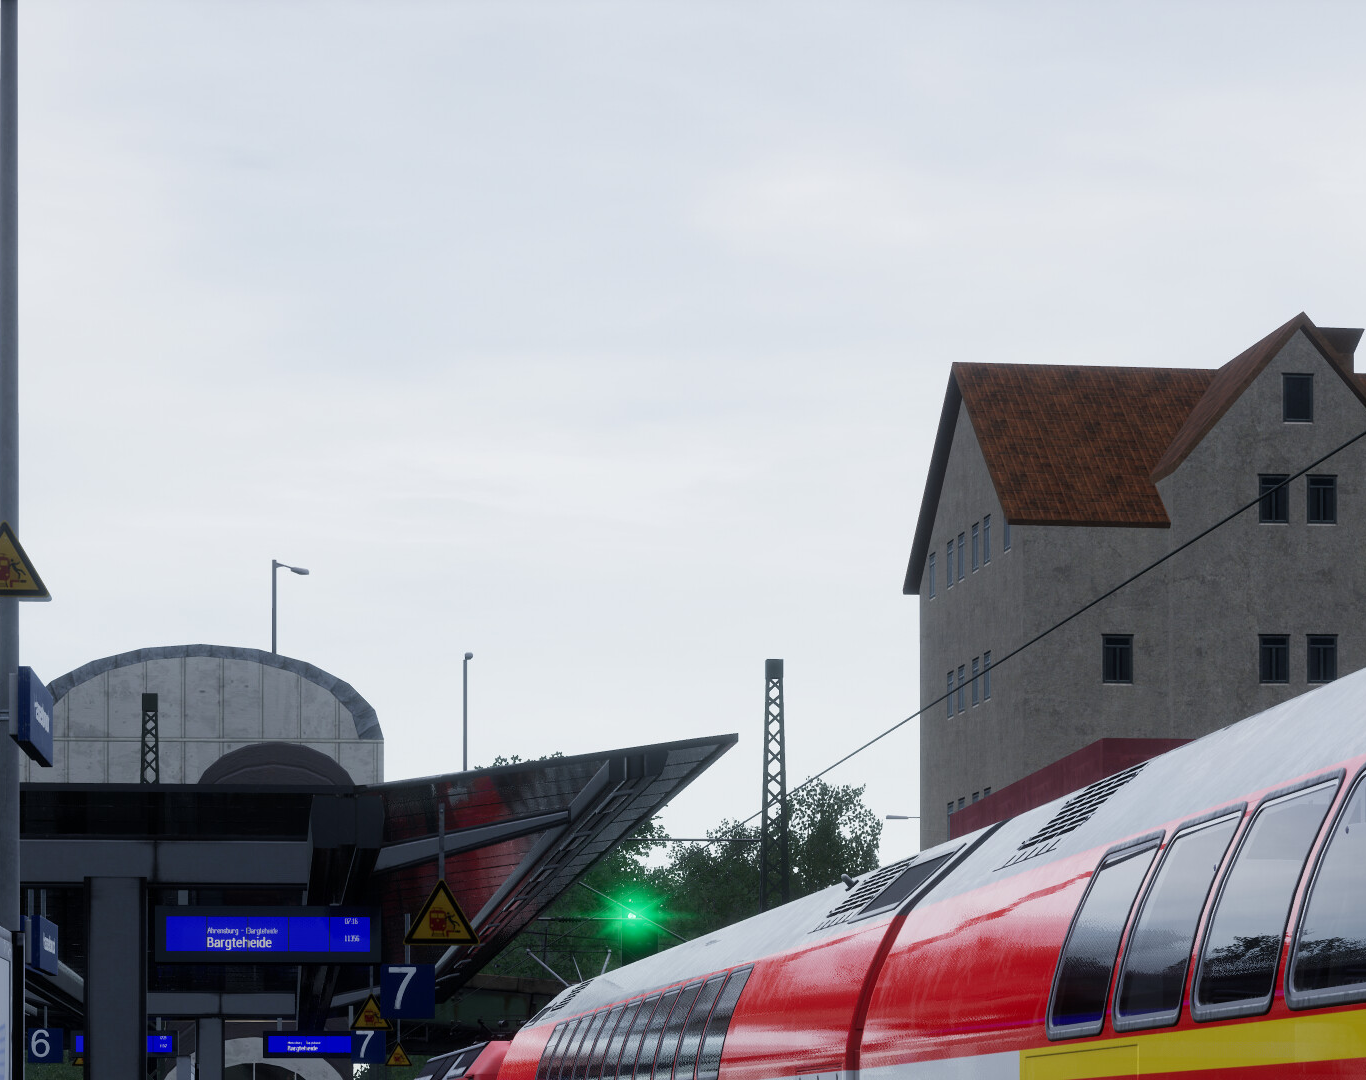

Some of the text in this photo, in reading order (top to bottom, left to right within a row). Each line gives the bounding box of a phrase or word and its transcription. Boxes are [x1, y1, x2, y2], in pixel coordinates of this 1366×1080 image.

[206, 936, 273, 951] Bargteheide
[388, 966, 417, 1010] 7
[31, 1029, 51, 1058] 6
[356, 1030, 375, 1058] 7
